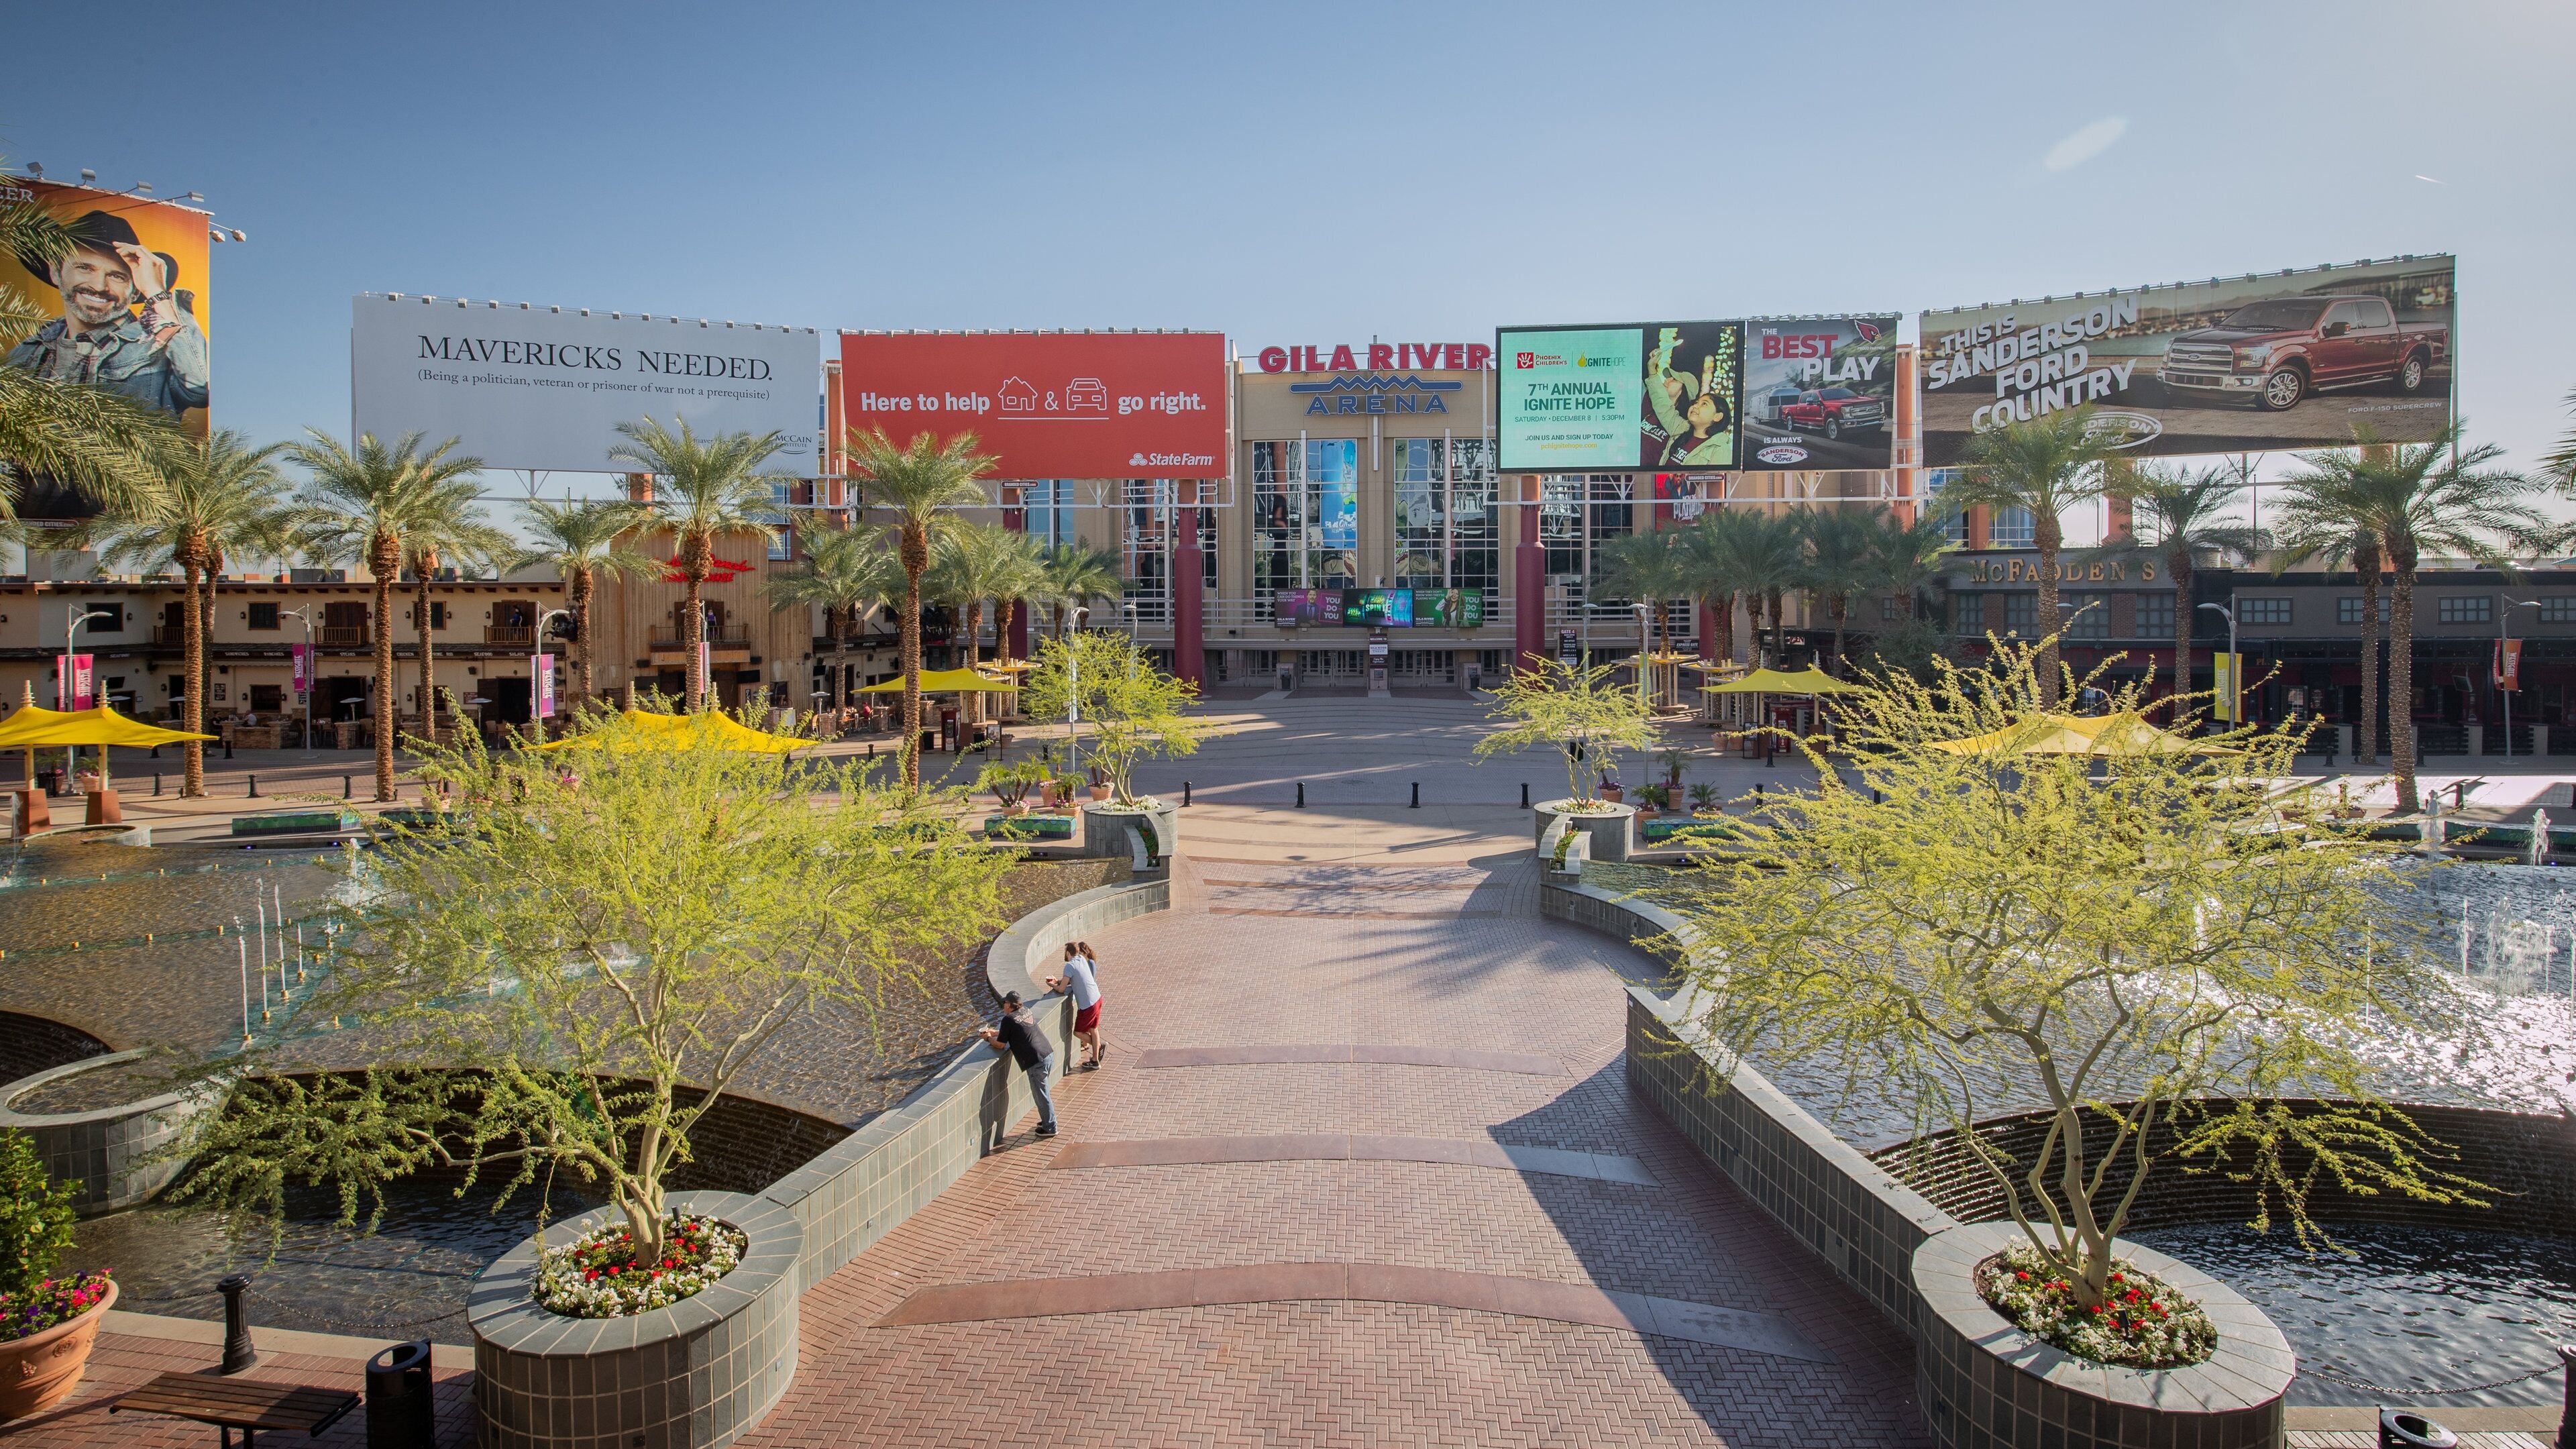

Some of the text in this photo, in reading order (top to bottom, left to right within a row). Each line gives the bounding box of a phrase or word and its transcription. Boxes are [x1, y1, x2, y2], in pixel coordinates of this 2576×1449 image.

[1762, 334, 1839, 359] BEST
[1927, 293, 2137, 390] SANDERSON
[1940, 313, 2017, 356] THIS IS
[418, 335, 773, 380] MAVERICKS NEEDED.
[1258, 343, 1494, 374] GILA RIVER
[1803, 357, 1880, 381] PLAY
[1996, 345, 2088, 399] FORD
[418, 369, 458, 385] (Being
[472, 373, 530, 387] politician,
[533, 377, 574, 388] veteran
[578, 380, 589, 388] or
[592, 380, 637, 392] prisoner
[641, 383, 653, 392] of
[655, 386, 674, 394] war
[678, 386, 695, 395] not
[706, 389, 770, 401] prerequisite)
[1528, 382, 1612, 396] 7TH ANNUAL
[1972, 358, 2137, 434] COUNTRY
[861, 391, 1206, 414] Here to help & go right.
[1305, 393, 1449, 416] ARENA
[1524, 396, 1615, 411] IGNITE HOPE
[2393, 402, 2442, 410] SUPERCREW
[1760, 448, 1804, 458] SANDERSON
[1772, 453, 1793, 463] Ford
[2507, 652, 2517, 677] WESTGATE
[80, 668, 91, 696] WESTGATE
